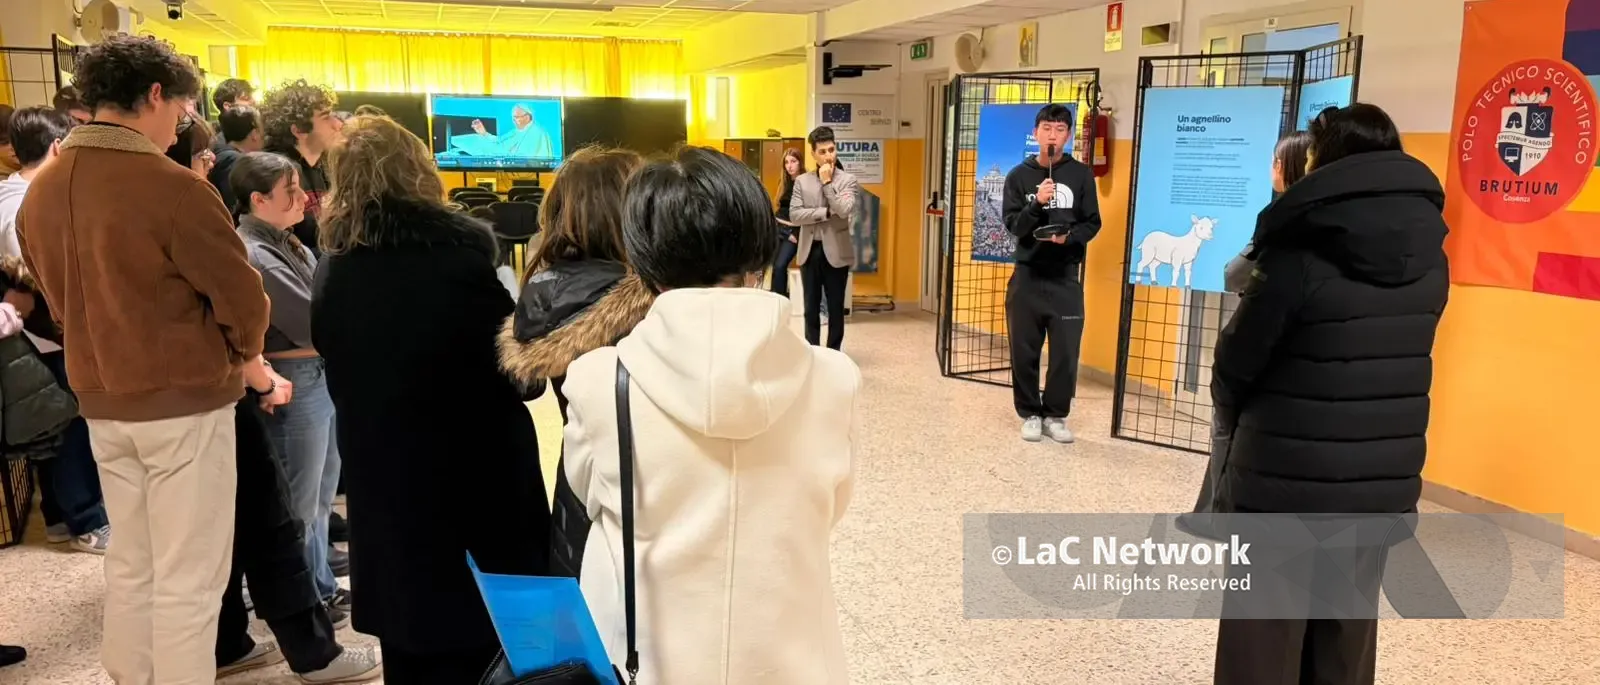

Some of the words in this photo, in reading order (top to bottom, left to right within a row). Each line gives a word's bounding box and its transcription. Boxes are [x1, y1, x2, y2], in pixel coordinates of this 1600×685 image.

[1177, 115, 1189, 123] Un
[1190, 114, 1232, 125] agnellino
[1462, 115, 1479, 162] POLO
[1476, 65, 1539, 109] TECNICO
[1544, 67, 1591, 164] SCIENTIFICO
[1176, 123, 1206, 132] bianco
[836, 142, 879, 152] UTURA
[1525, 152, 1542, 160] 1910
[1479, 179, 1558, 196] BRUTIUM
